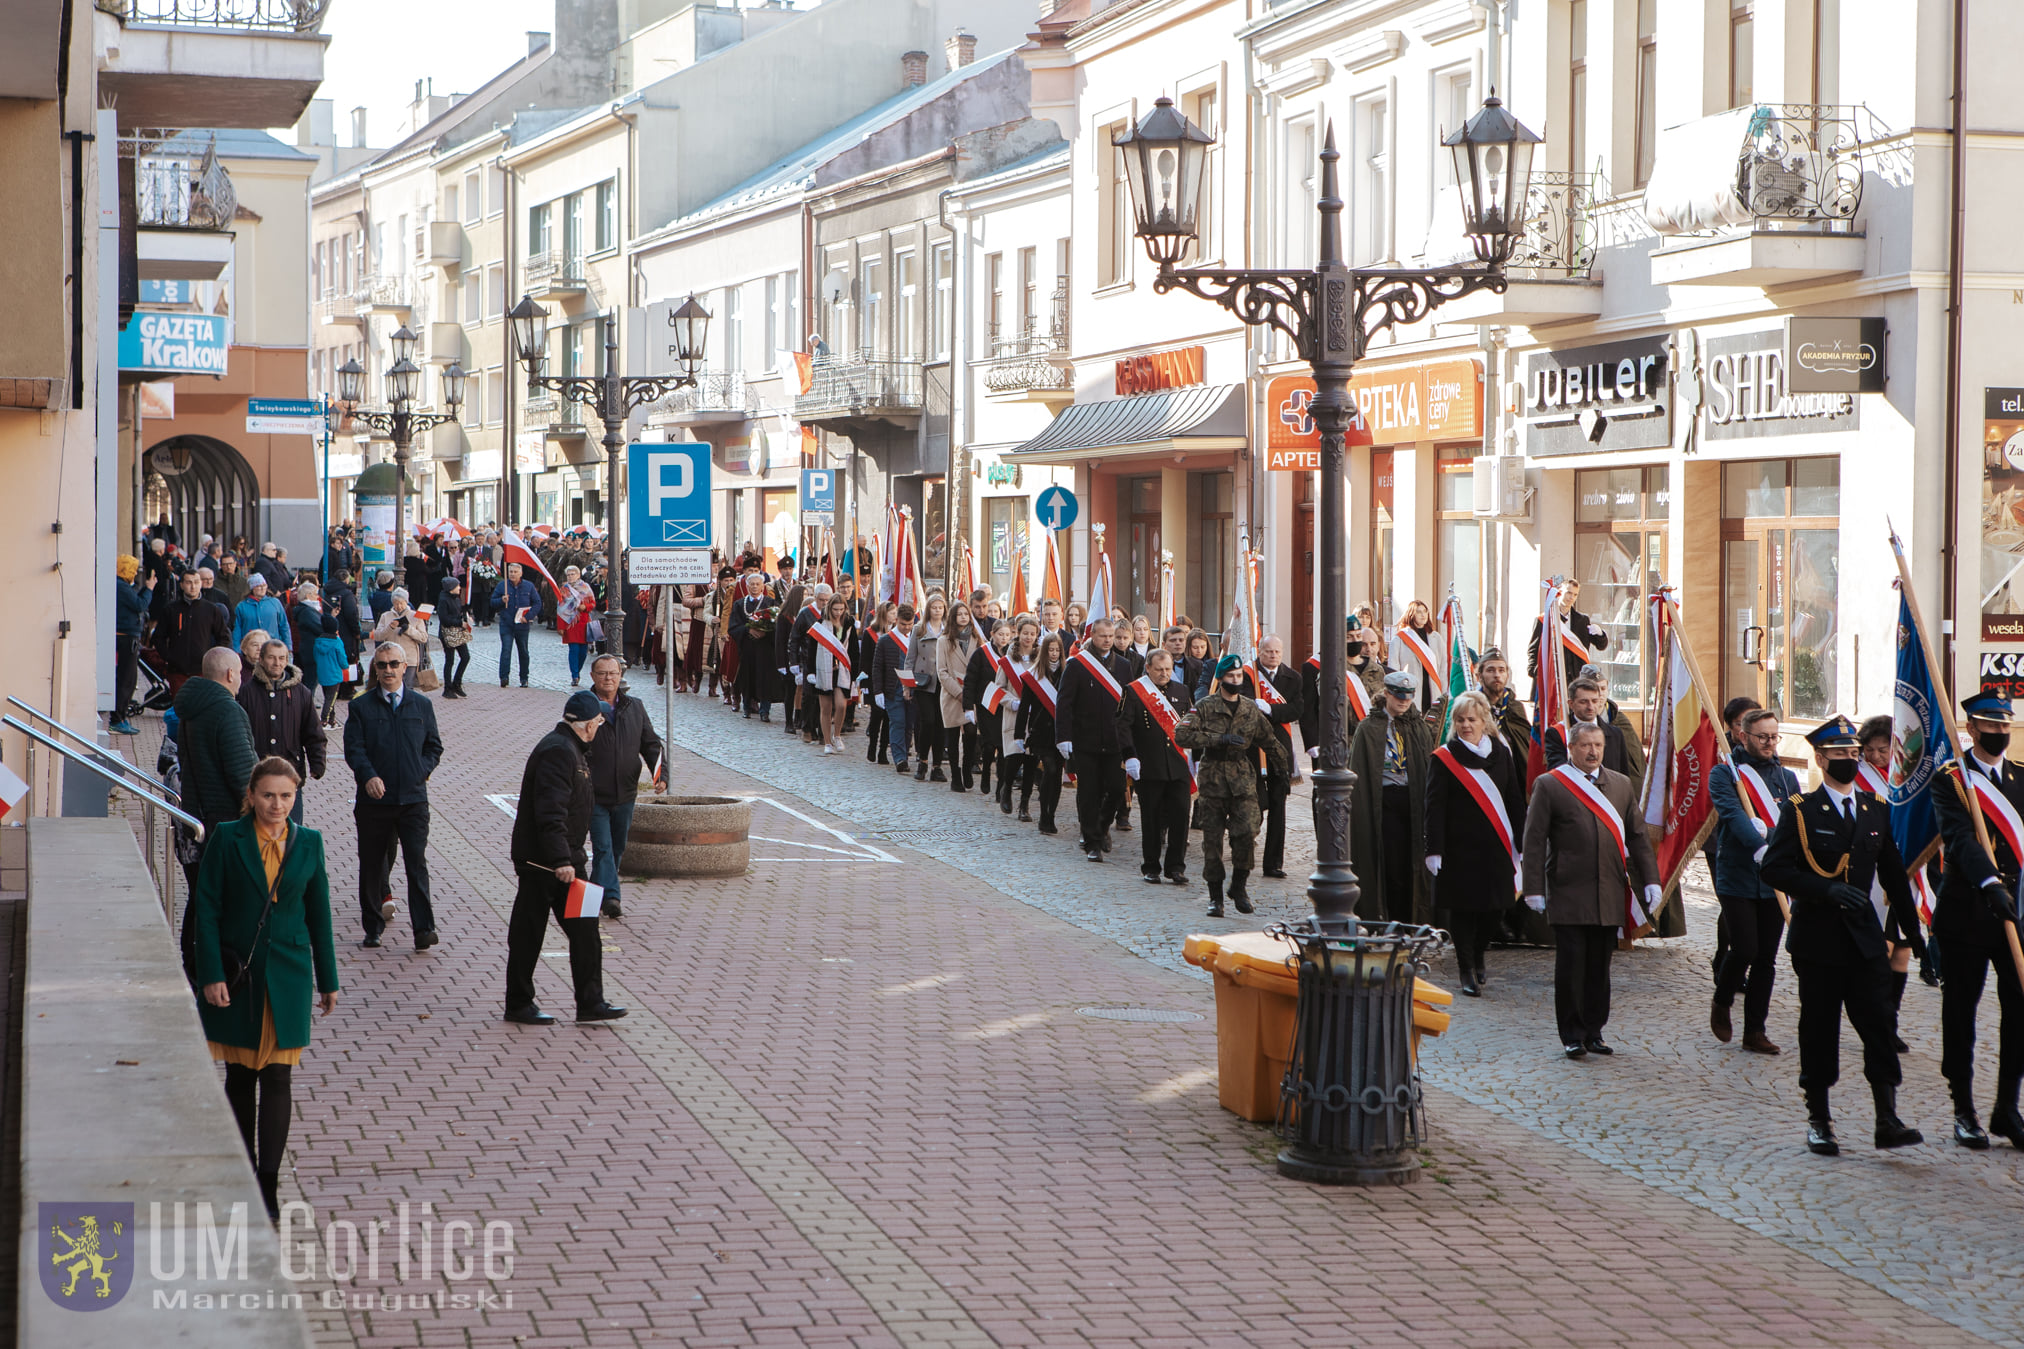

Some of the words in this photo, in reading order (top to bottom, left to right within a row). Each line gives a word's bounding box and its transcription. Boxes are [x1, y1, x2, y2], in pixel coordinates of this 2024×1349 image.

[140, 316, 214, 341] GAZETA
[1802, 351, 1840, 360] AKADEMIA
[1842, 352, 1871, 361] FRYZUR
[1115, 346, 1204, 396] ROSSMANN
[1429, 379, 1461, 402] zdrowe
[1708, 349, 1785, 425] SHE
[1429, 400, 1450, 423] ceny
[1783, 391, 1848, 419] boutique
[648, 453, 694, 516] P
[809, 472, 829, 499] P
[1678, 743, 1701, 817] GORLICKI
